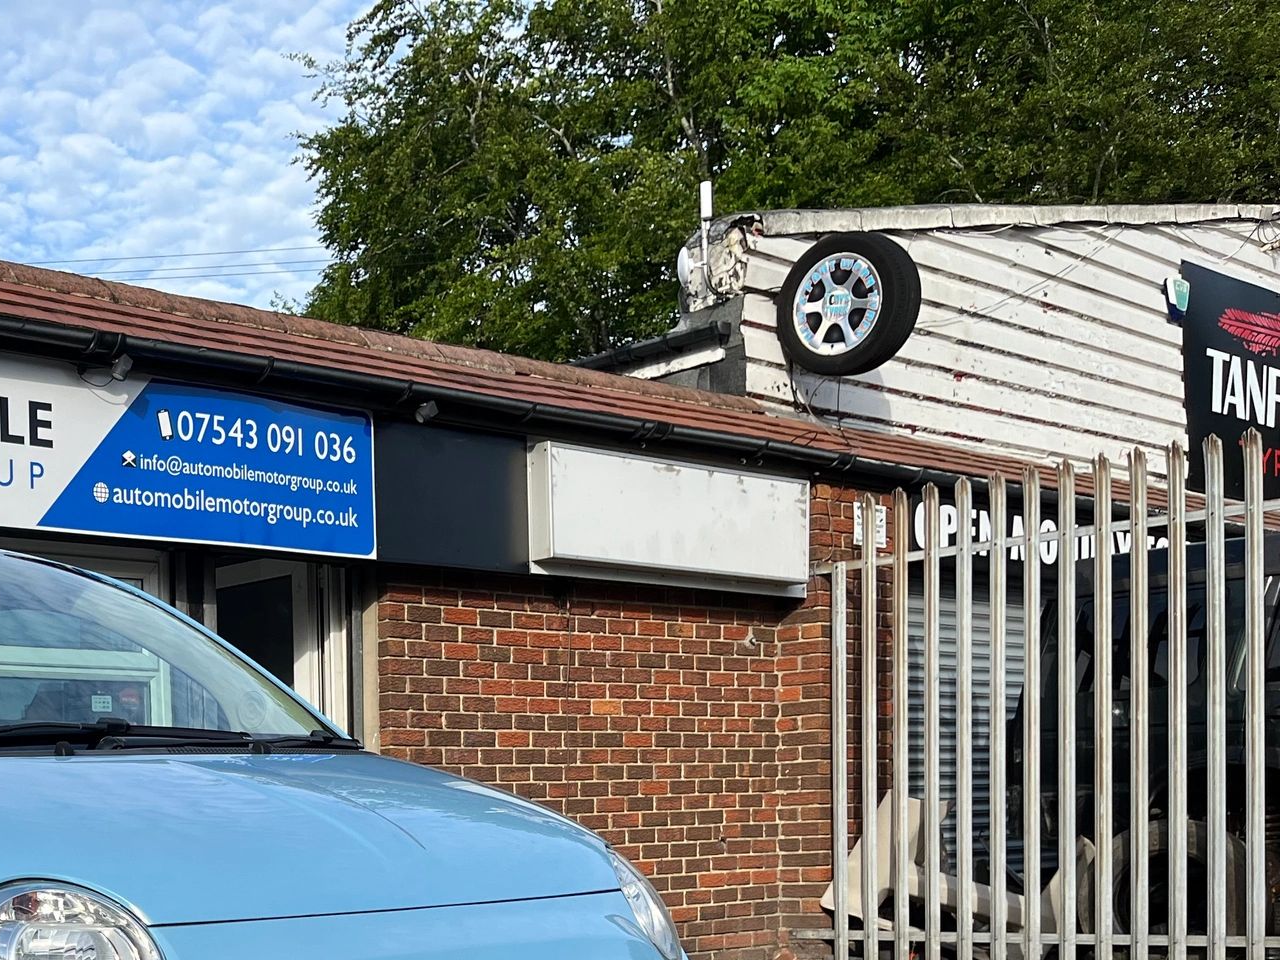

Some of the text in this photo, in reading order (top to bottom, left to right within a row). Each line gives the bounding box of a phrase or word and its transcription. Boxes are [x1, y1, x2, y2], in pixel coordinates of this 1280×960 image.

[177, 410, 357, 464] 07543 091 036
[139, 454, 358, 496] info@automobilemotorgroup.co.uk
[112, 485, 359, 528] automobilemotorgroup.co.uk
